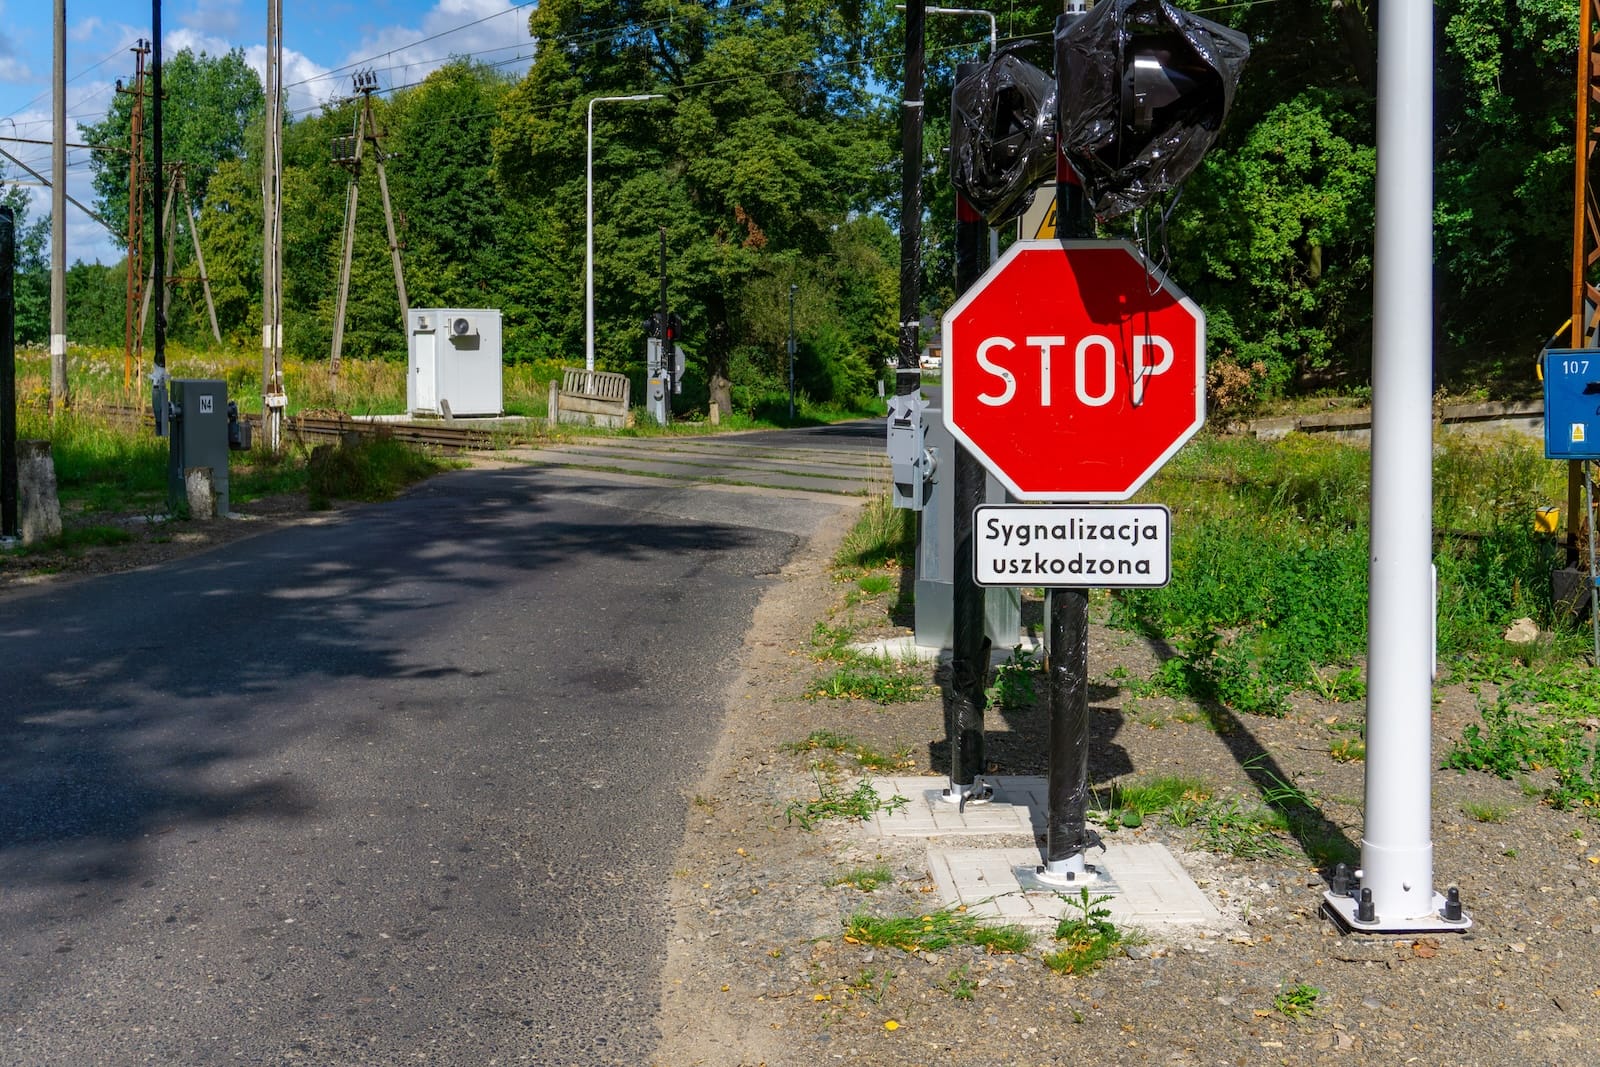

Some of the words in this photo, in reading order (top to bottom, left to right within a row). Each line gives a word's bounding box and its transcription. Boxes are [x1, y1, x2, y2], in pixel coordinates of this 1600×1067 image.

[976, 335, 1174, 407] STOP
[1562, 360, 1589, 375] 107
[201, 399, 212, 410] N4
[985, 518, 1158, 546] Sygnalizacja
[992, 552, 1150, 575] uszkodzona
